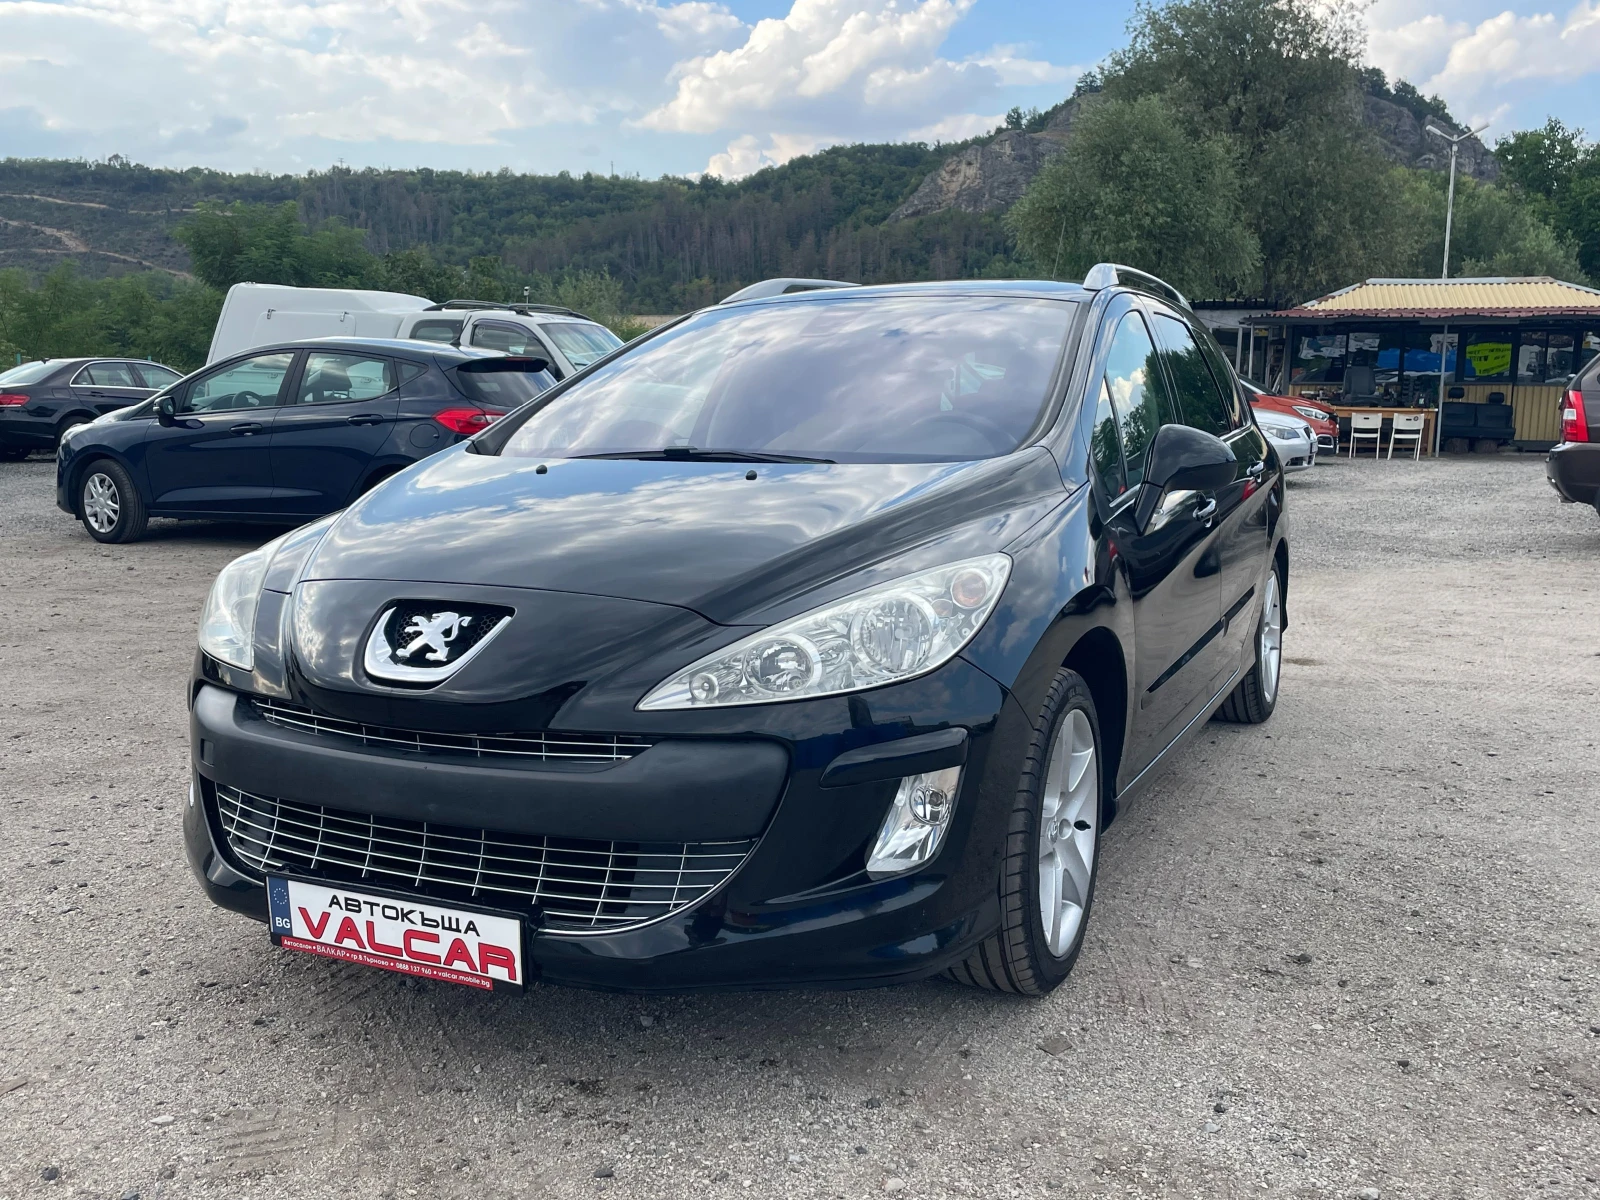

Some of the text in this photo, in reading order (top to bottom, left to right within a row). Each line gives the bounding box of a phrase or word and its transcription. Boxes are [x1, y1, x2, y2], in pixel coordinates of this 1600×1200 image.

[275, 916, 291, 929] BG
[328, 894, 481, 937] АВТОКЪЩА
[284, 939, 312, 949] Автосалон
[316, 944, 346, 957] ВАЛКАР
[395, 962, 409, 971] 0888
[410, 965, 420, 973] 137
[421, 967, 432, 975] 960
[438, 971, 490, 988] valcar.mobile.bg
[298, 907, 517, 981] VALCAR
